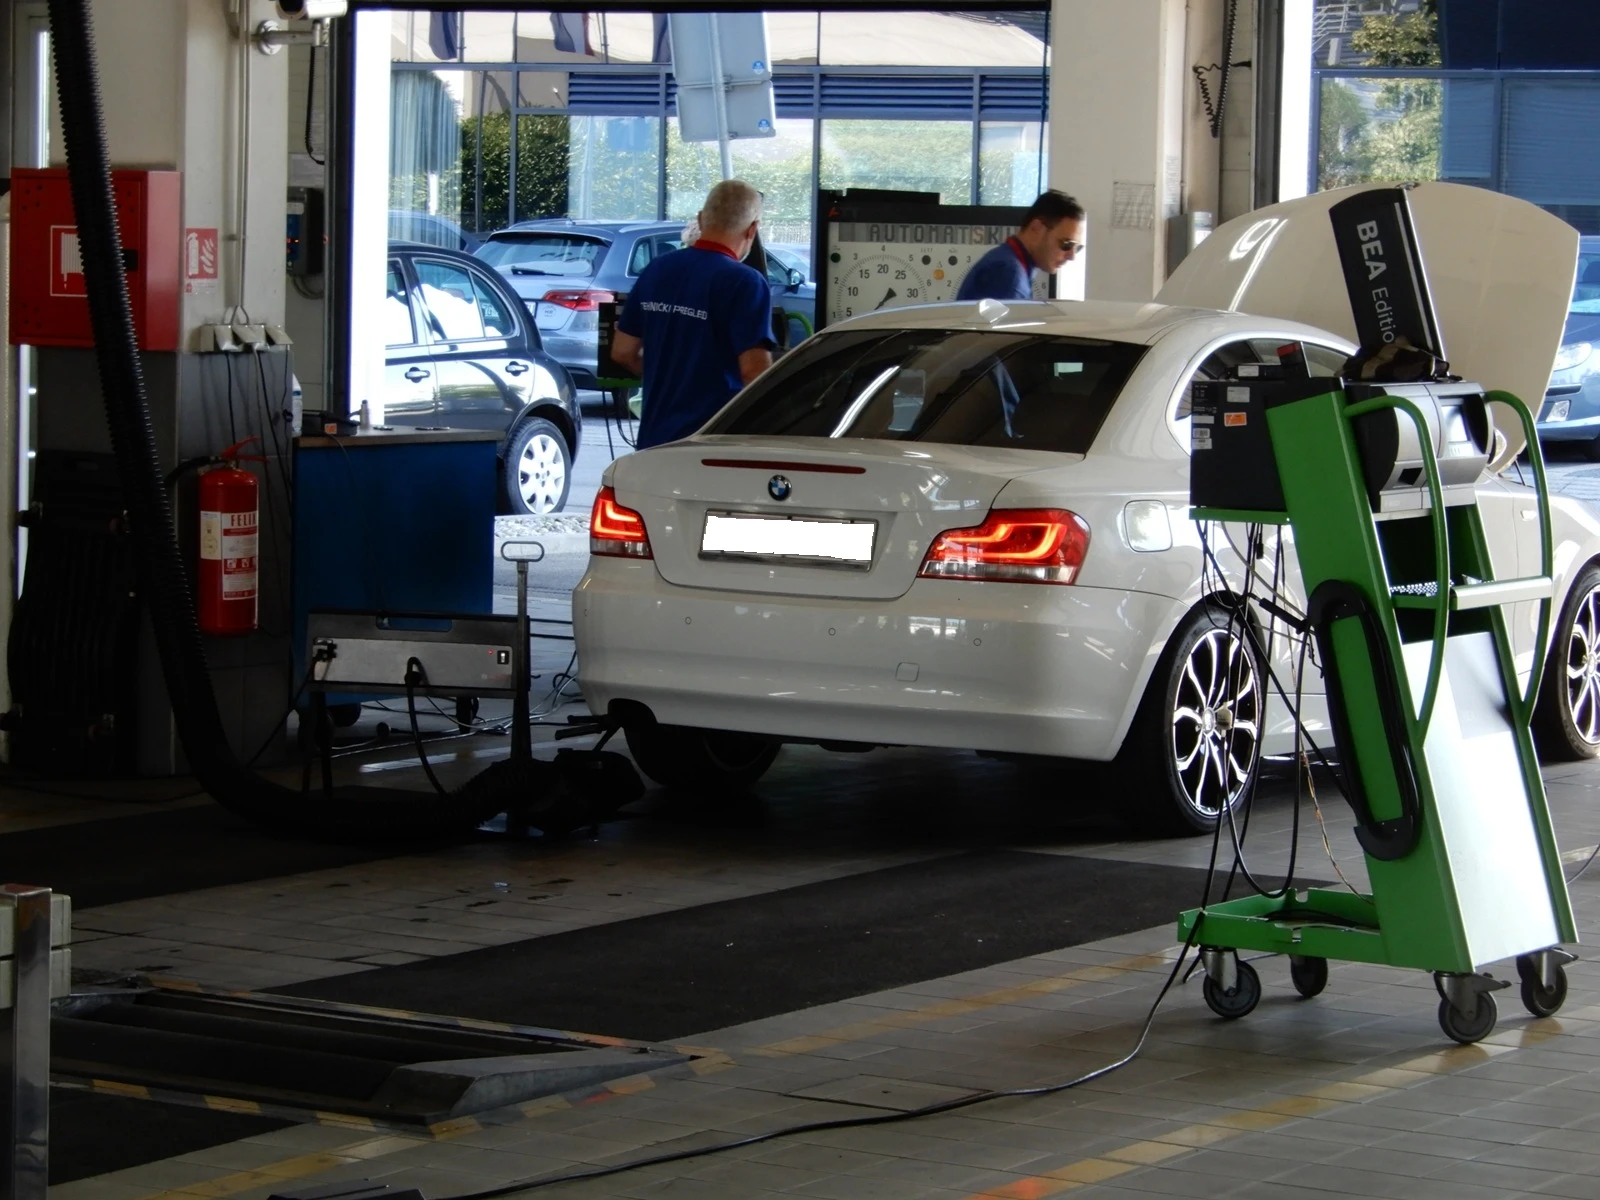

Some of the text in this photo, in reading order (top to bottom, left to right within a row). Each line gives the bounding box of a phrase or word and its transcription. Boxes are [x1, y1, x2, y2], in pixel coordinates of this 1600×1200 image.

[859, 269, 870, 279] 15
[877, 264, 889, 274] 20
[895, 270, 906, 280] 25
[1356, 220, 1397, 344] BEA Editio
[847, 287, 858, 296] 10
[907, 288, 918, 298] 30
[846, 307, 852, 317] 5
